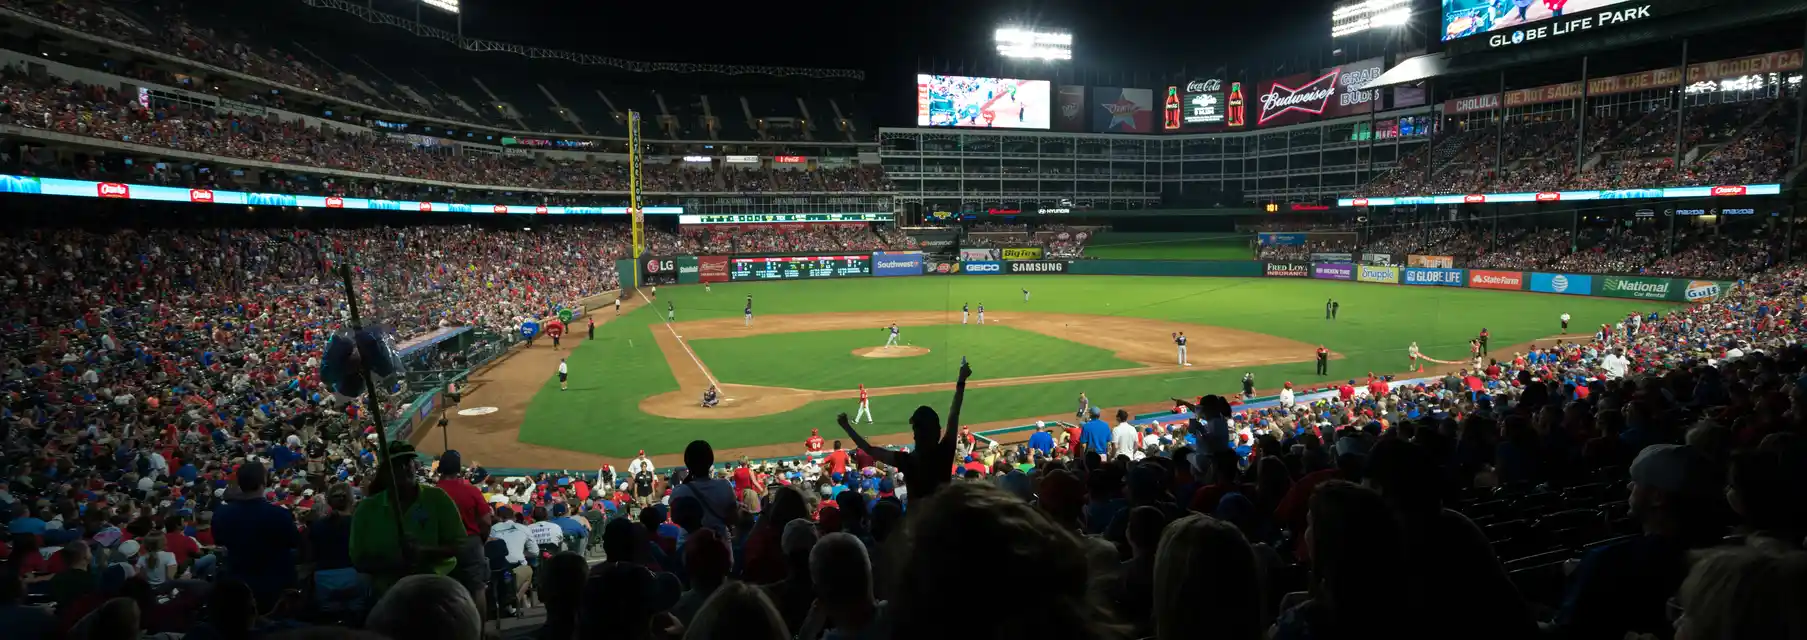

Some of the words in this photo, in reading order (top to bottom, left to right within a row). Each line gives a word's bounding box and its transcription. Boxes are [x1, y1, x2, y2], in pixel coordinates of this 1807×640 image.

[1489, 26, 1547, 47] GLOBE
[1553, 17, 1593, 36] LIFE
[1598, 5, 1651, 27] PARK
[1456, 95, 1499, 112] CHOLULA
[1588, 77, 1619, 94] WITH
[1625, 73, 1649, 89] THE
[1705, 55, 1772, 78] WOODEN
[1261, 87, 1336, 111] Budweiser
[660, 260, 674, 271] LG
[877, 260, 914, 269] Southwest
[966, 264, 999, 272] GEICO
[1012, 262, 1062, 272] SAMSUNG
[1267, 262, 1287, 271] FRED
[1362, 265, 1394, 280] Snapple
[1416, 270, 1443, 282] GLOBE
[1445, 271, 1460, 283] LIFE
[1617, 280, 1668, 293] National
[1687, 285, 1718, 298] Gulf
